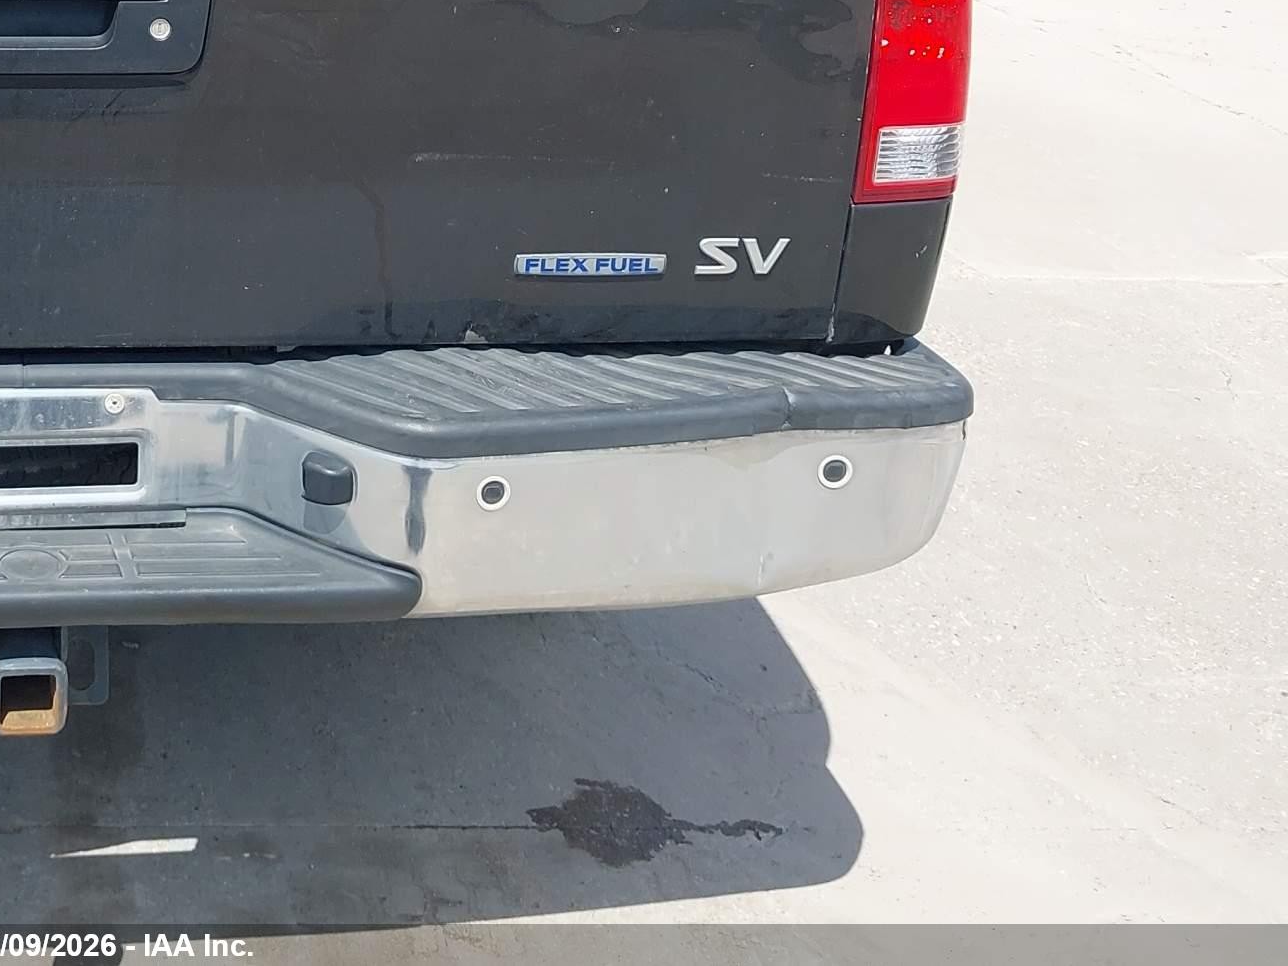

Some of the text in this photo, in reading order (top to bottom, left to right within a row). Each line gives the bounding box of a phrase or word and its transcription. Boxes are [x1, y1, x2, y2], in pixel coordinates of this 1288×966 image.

[524, 257, 659, 273] FLEX FUEL
[694, 237, 791, 275] SV
